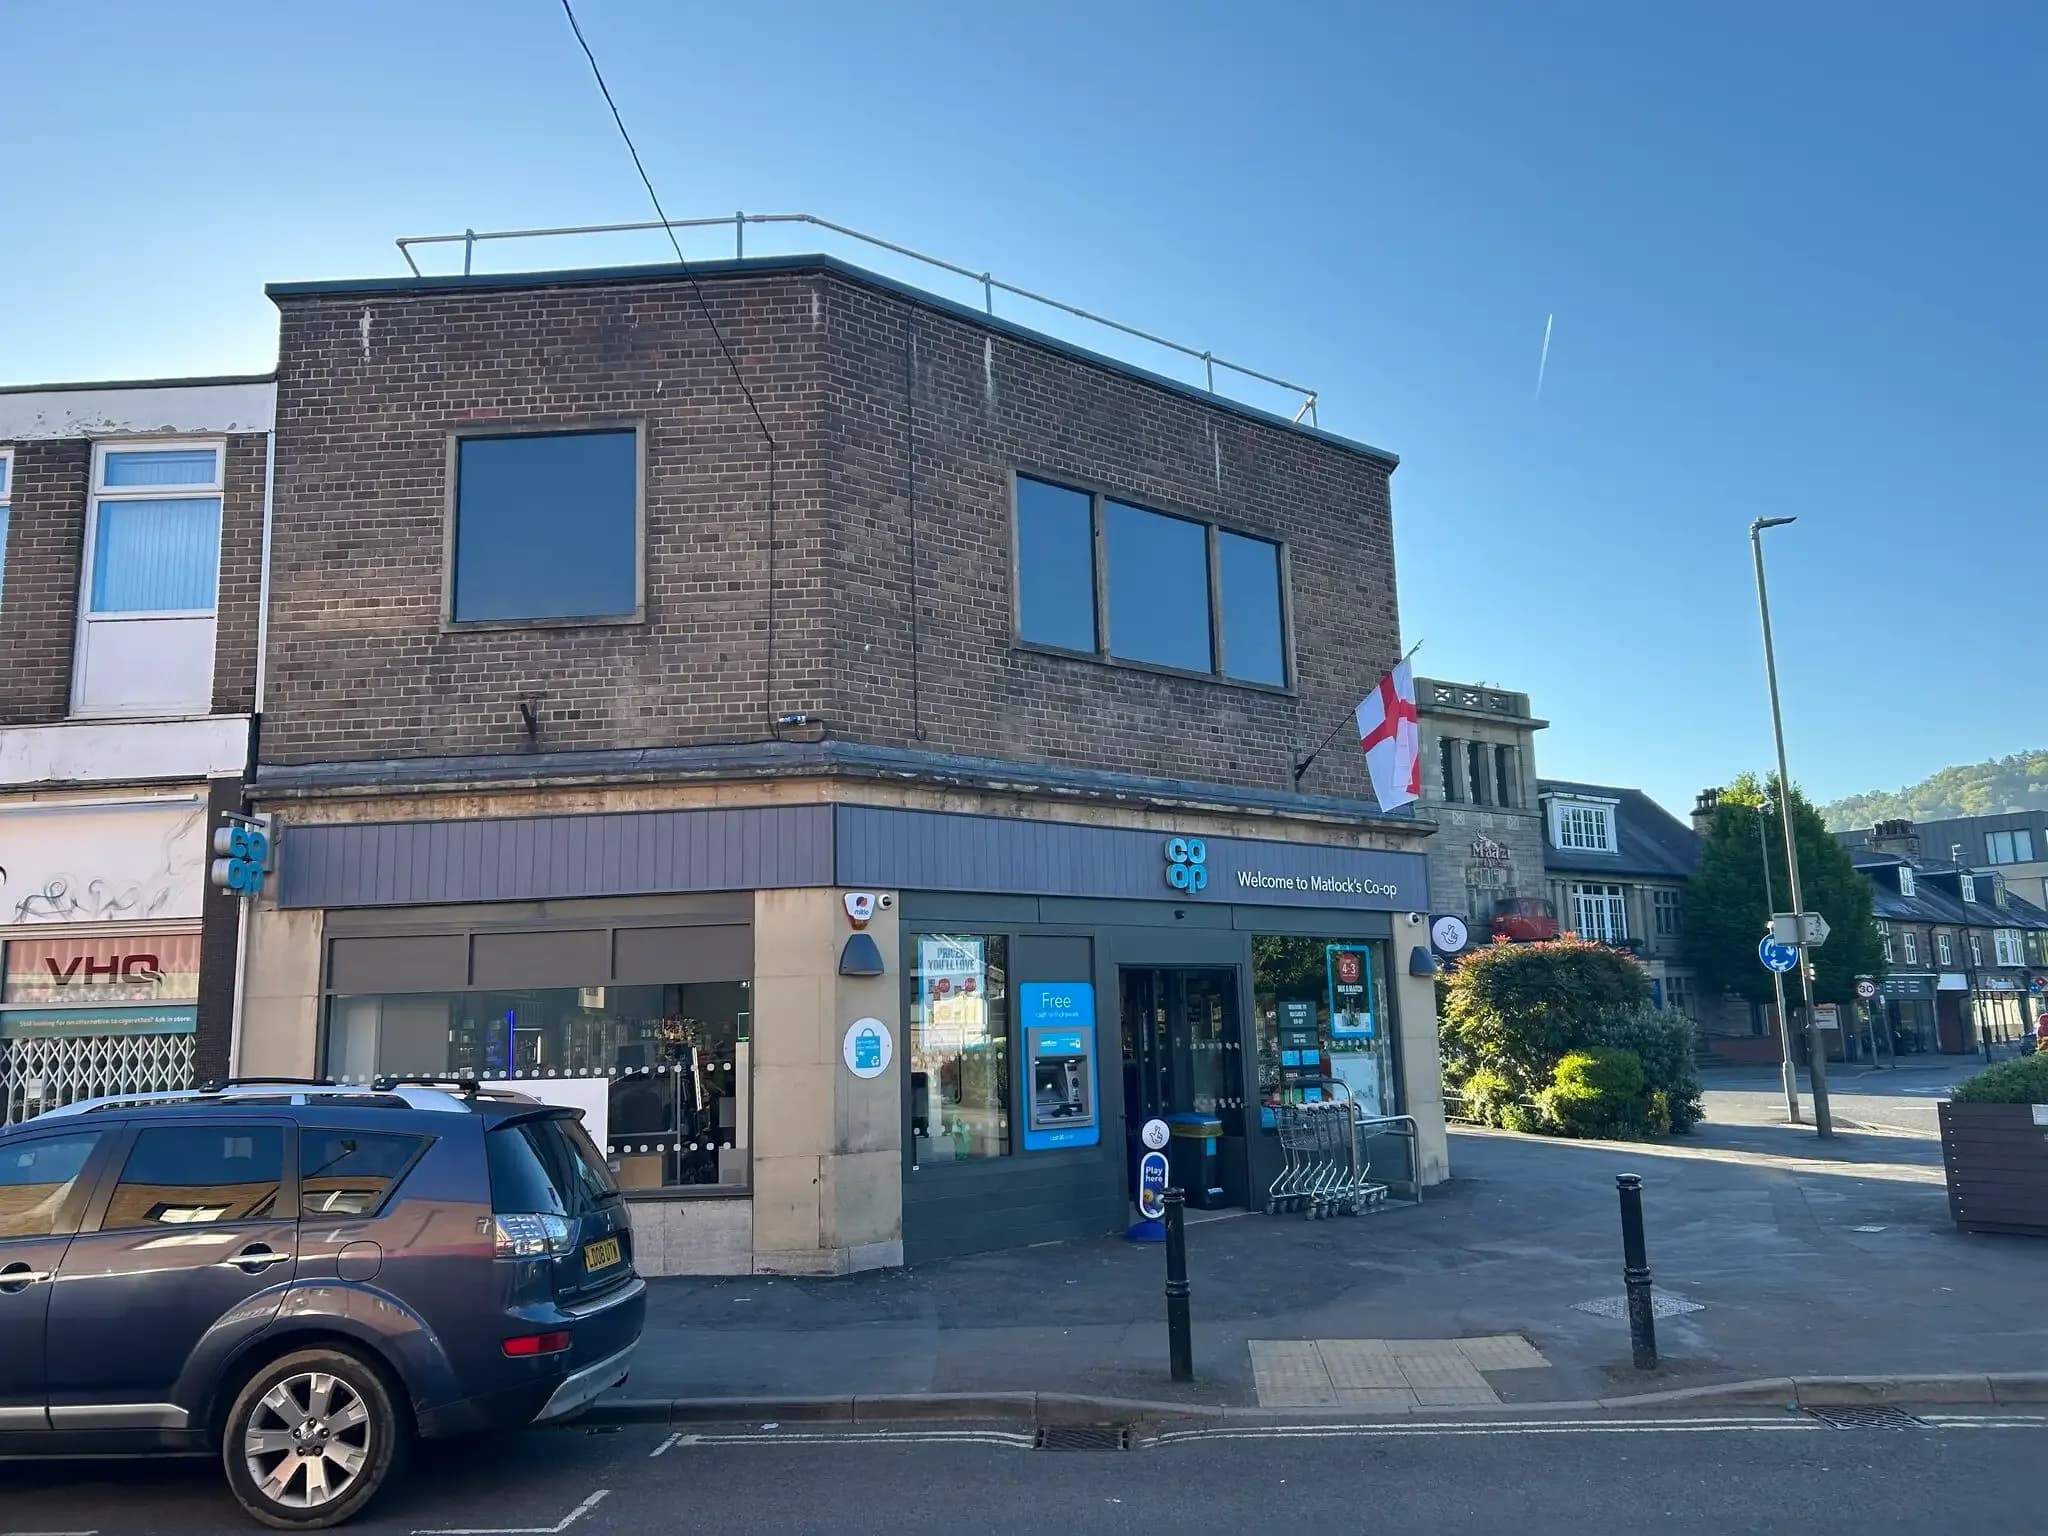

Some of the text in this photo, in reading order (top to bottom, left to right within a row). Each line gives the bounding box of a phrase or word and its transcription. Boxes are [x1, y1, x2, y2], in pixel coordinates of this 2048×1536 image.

[1166, 838, 1206, 864] co
[1168, 863, 1208, 894] op
[1237, 871, 1397, 898] Welcome to Matlock's Co-op
[1859, 985, 1873, 993] 30
[1042, 992, 1072, 1008] Free
[1146, 1166, 1163, 1176] Play
